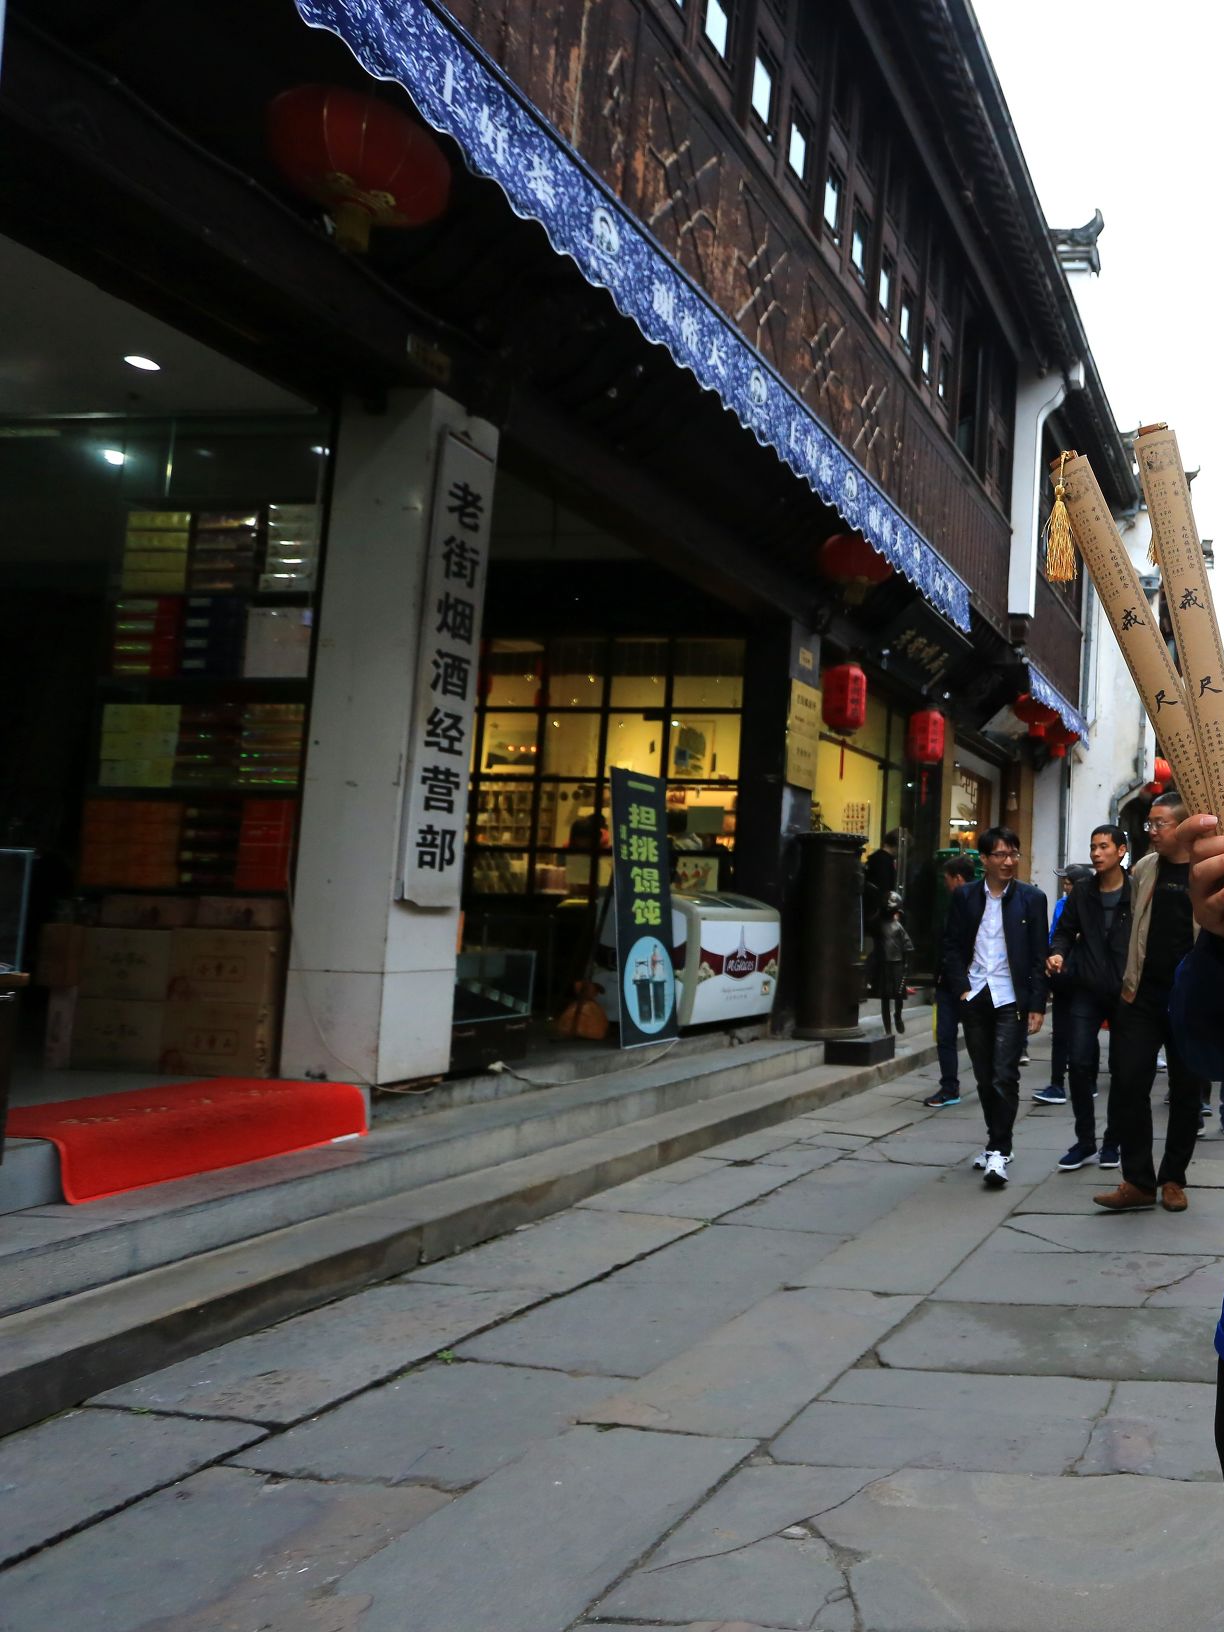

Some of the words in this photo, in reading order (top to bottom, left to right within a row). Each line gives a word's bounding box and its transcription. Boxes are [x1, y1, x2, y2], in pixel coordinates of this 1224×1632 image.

[415, 481, 486, 873] 老街烟酒经营部
[626, 779, 662, 926] 一担挑馄饨
